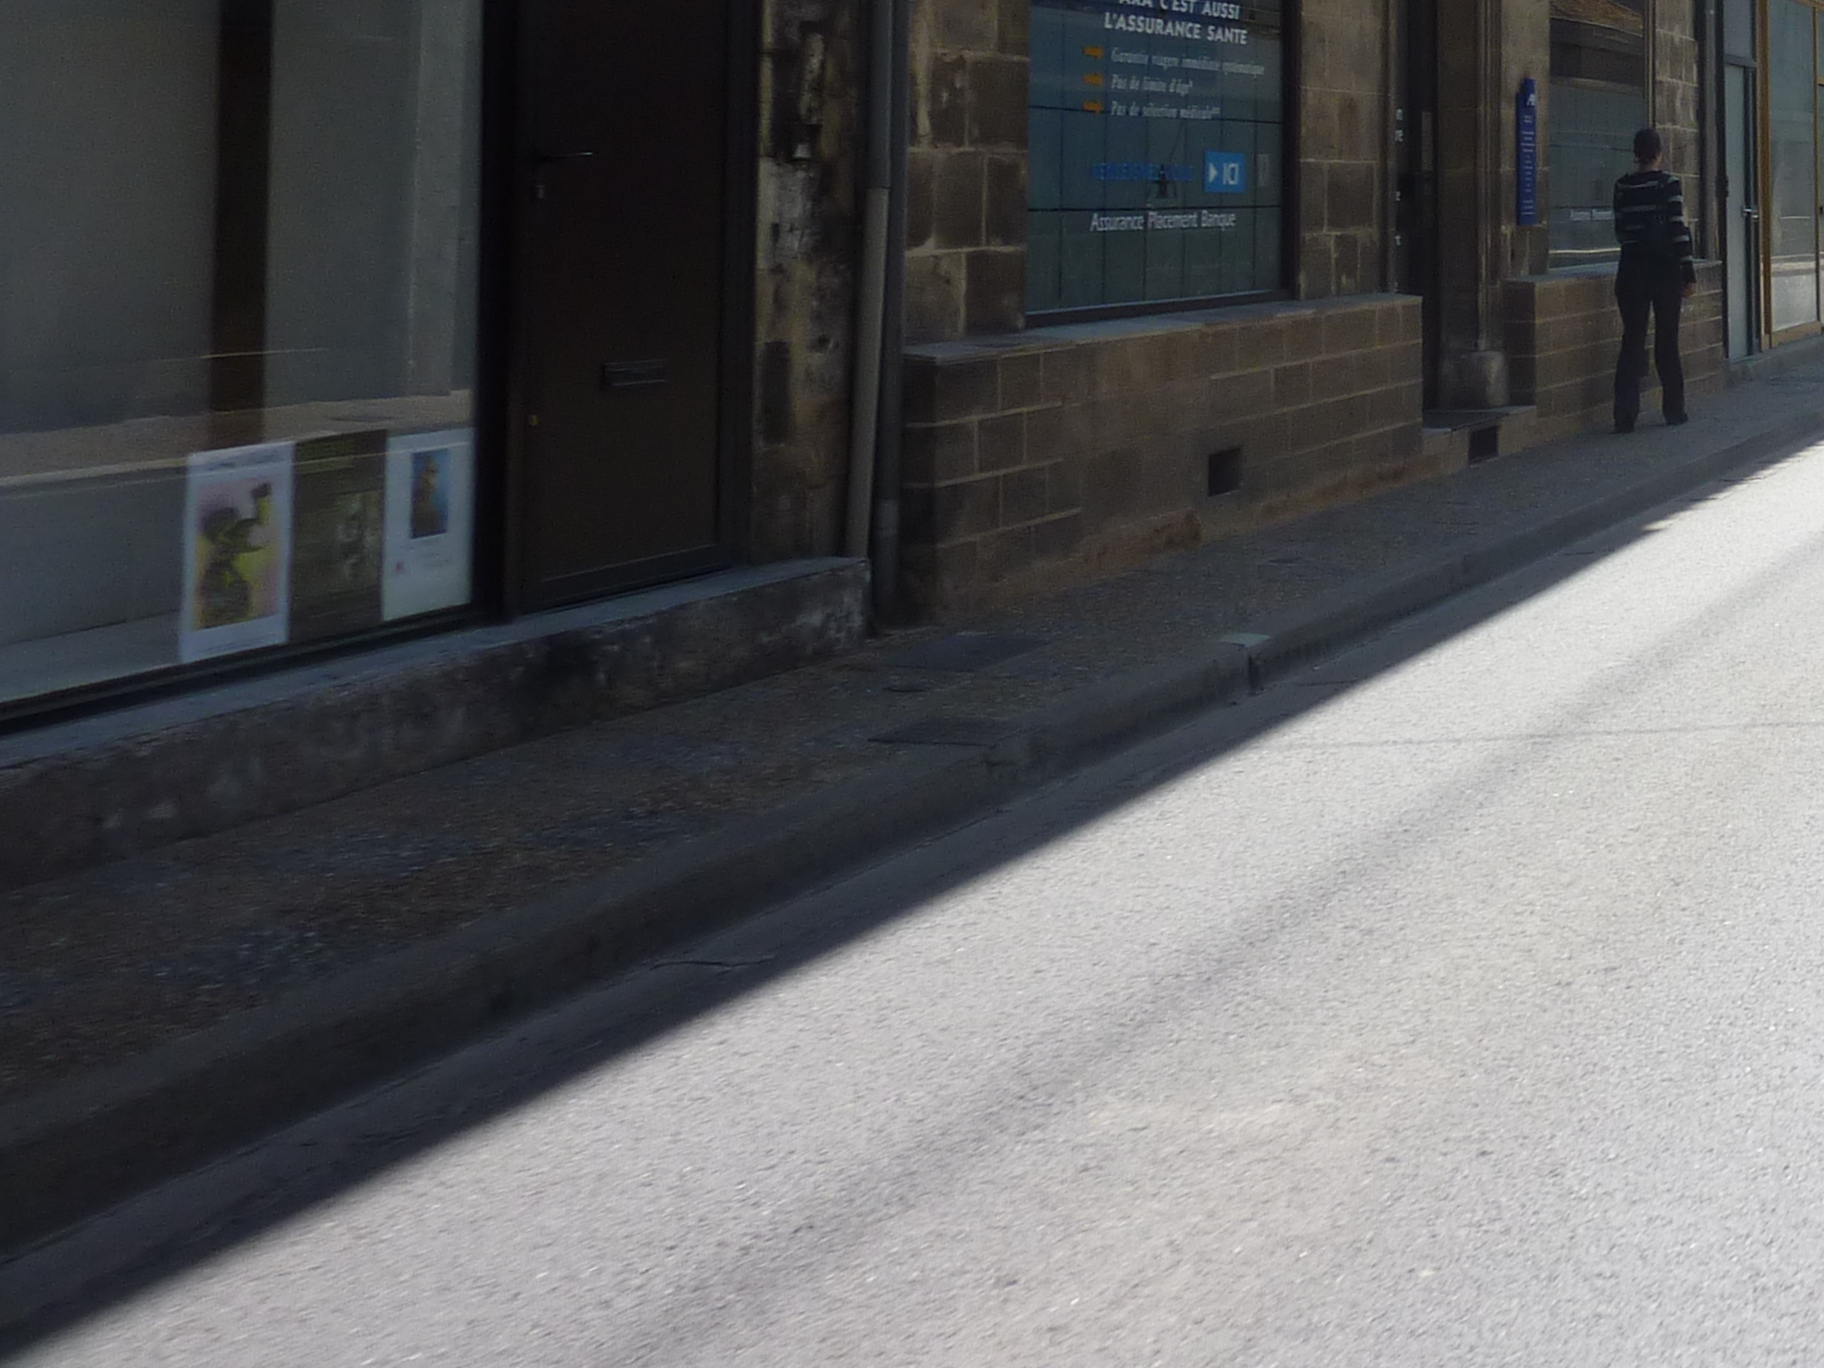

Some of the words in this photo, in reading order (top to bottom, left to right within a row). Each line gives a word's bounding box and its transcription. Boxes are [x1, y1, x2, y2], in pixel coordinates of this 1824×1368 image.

[1201, 0, 1240, 20] AUSSI
[1104, 12, 1201, 39] L'ASSURANCE
[1206, 25, 1248, 45] SANTE
[1090, 212, 1144, 232] Assurance
[1147, 210, 1198, 230] Placement
[1200, 210, 1236, 232] Banque
